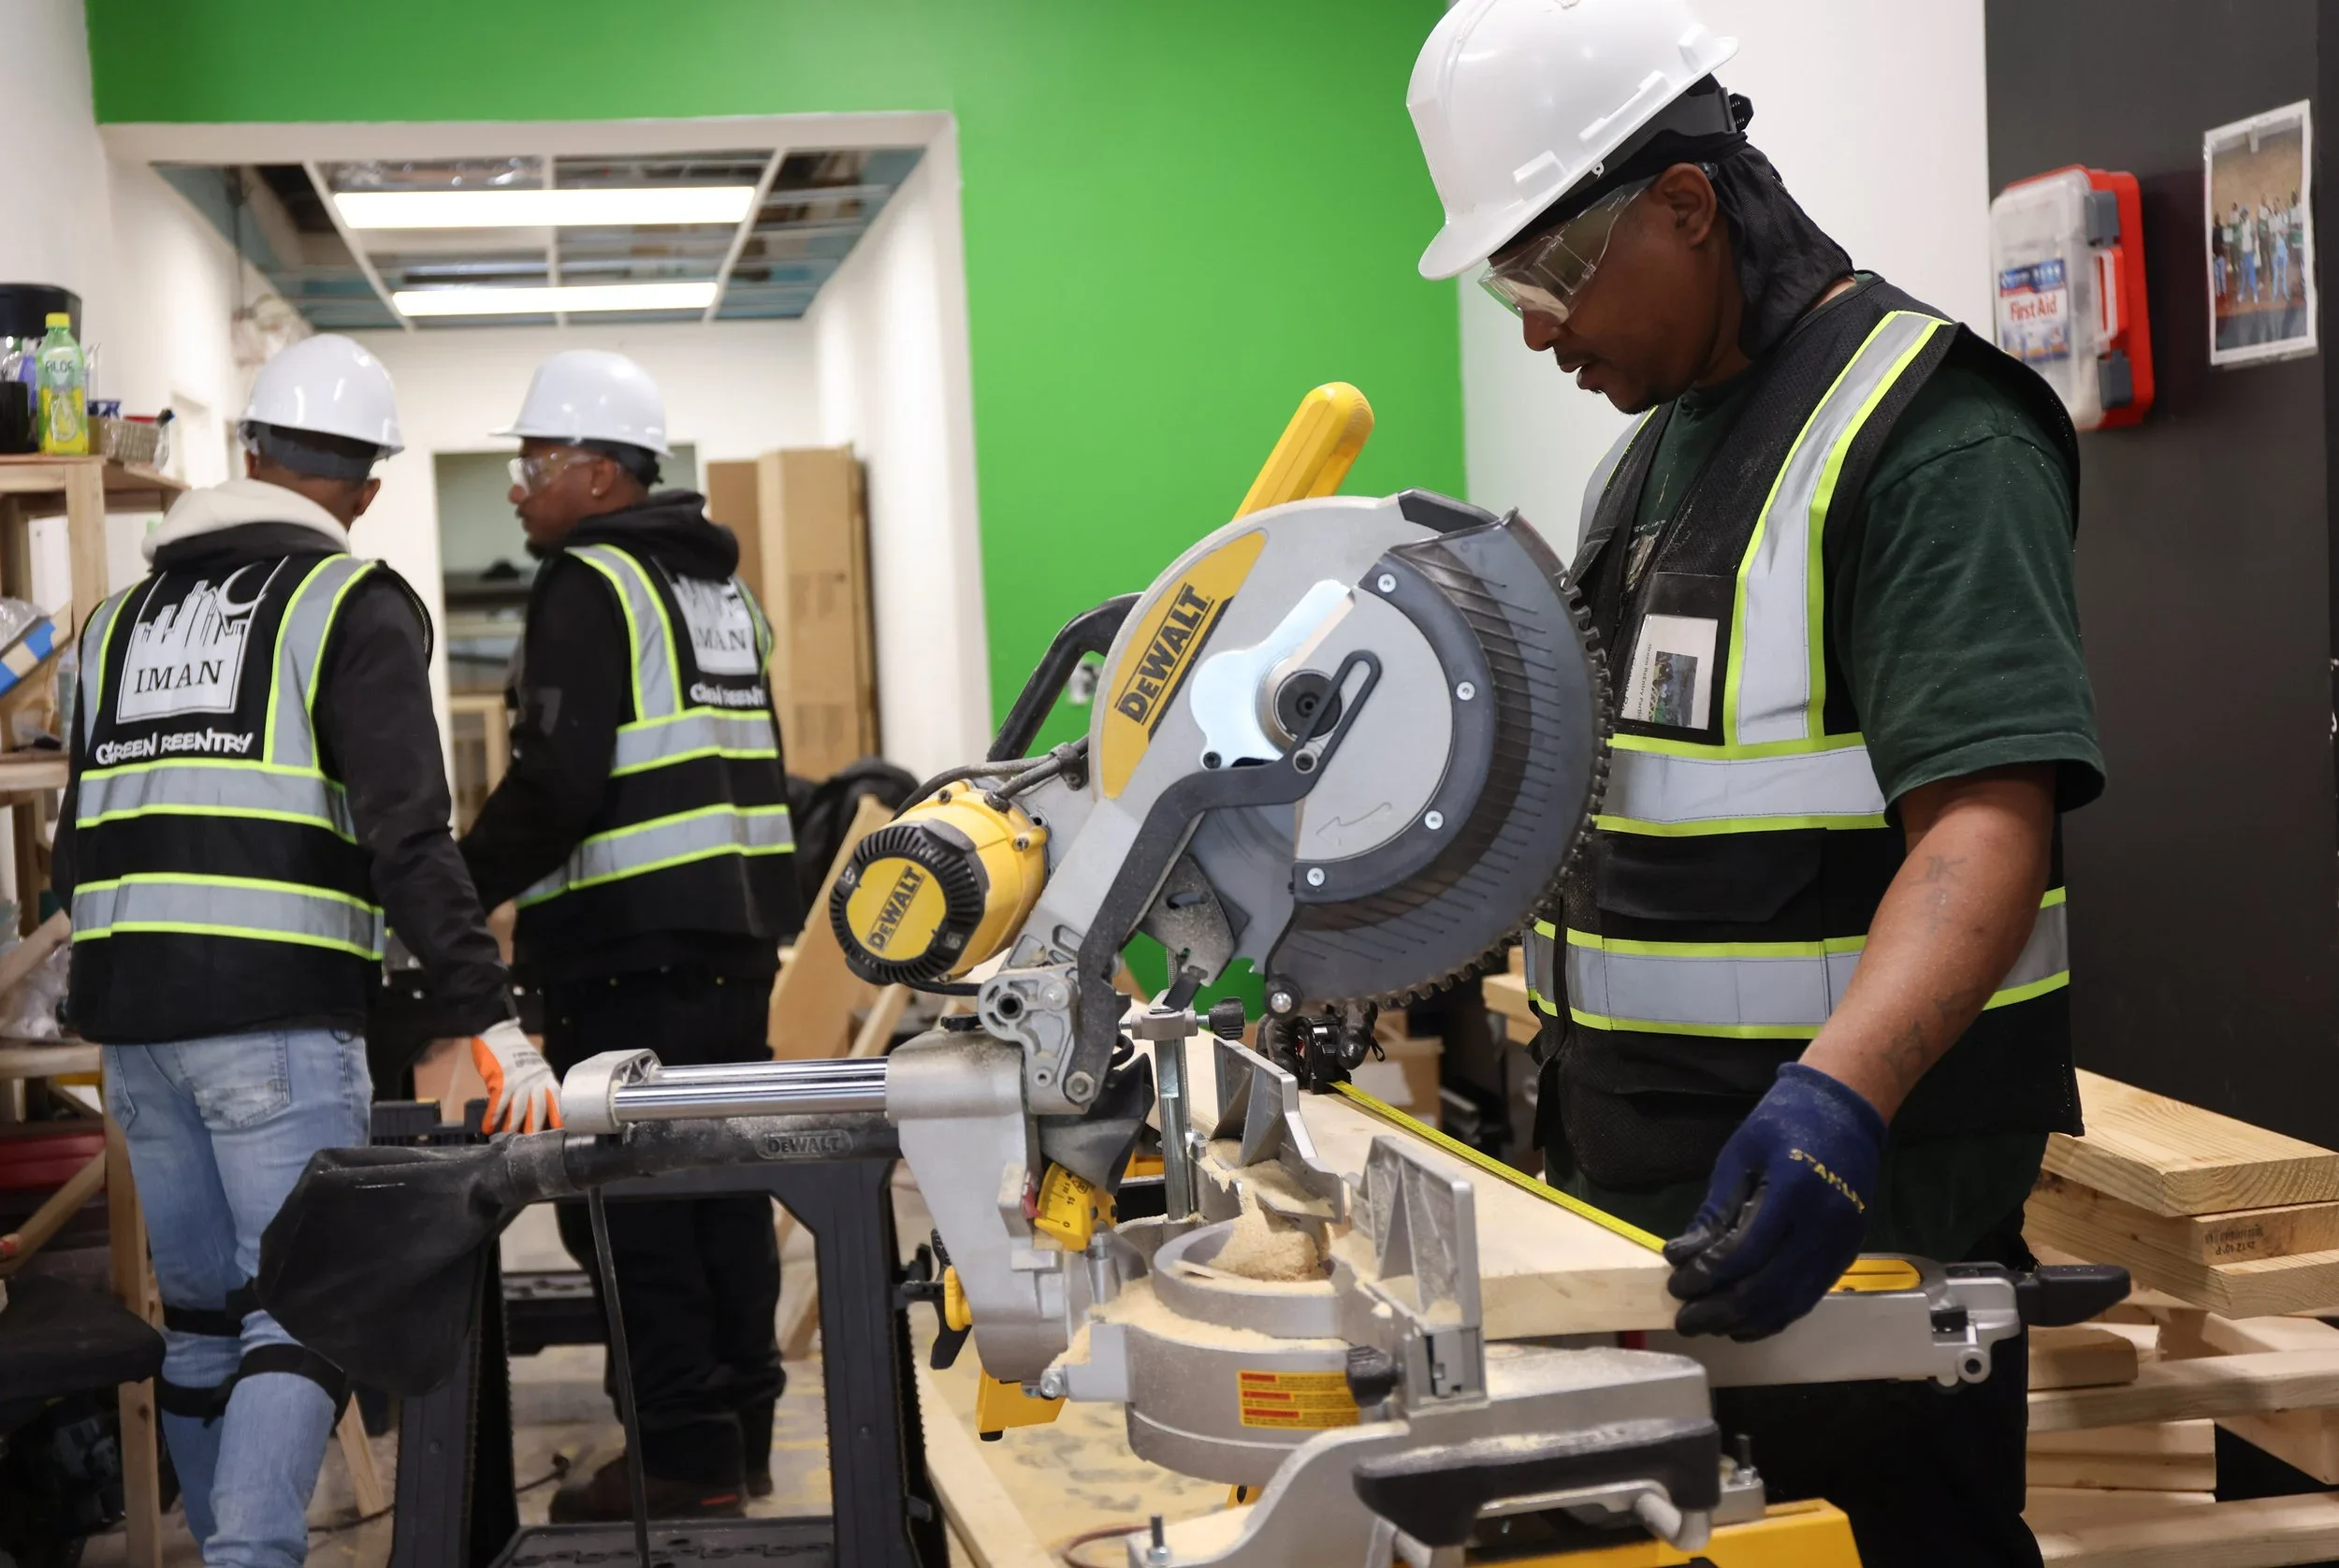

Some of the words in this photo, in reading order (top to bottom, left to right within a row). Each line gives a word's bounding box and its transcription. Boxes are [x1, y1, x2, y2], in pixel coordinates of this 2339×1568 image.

[2009, 300, 2036, 322] First
[2038, 294, 2057, 316] Aid
[46, 359, 74, 371] ALOE
[694, 627, 747, 650] MAN
[1118, 585, 1209, 723] DEWALT
[134, 660, 225, 694] IMAN
[95, 732, 157, 764] GREEN
[160, 727, 254, 754] REENTRY
[867, 865, 923, 951] DEWALT
[768, 1135, 840, 1154] DEWALT
